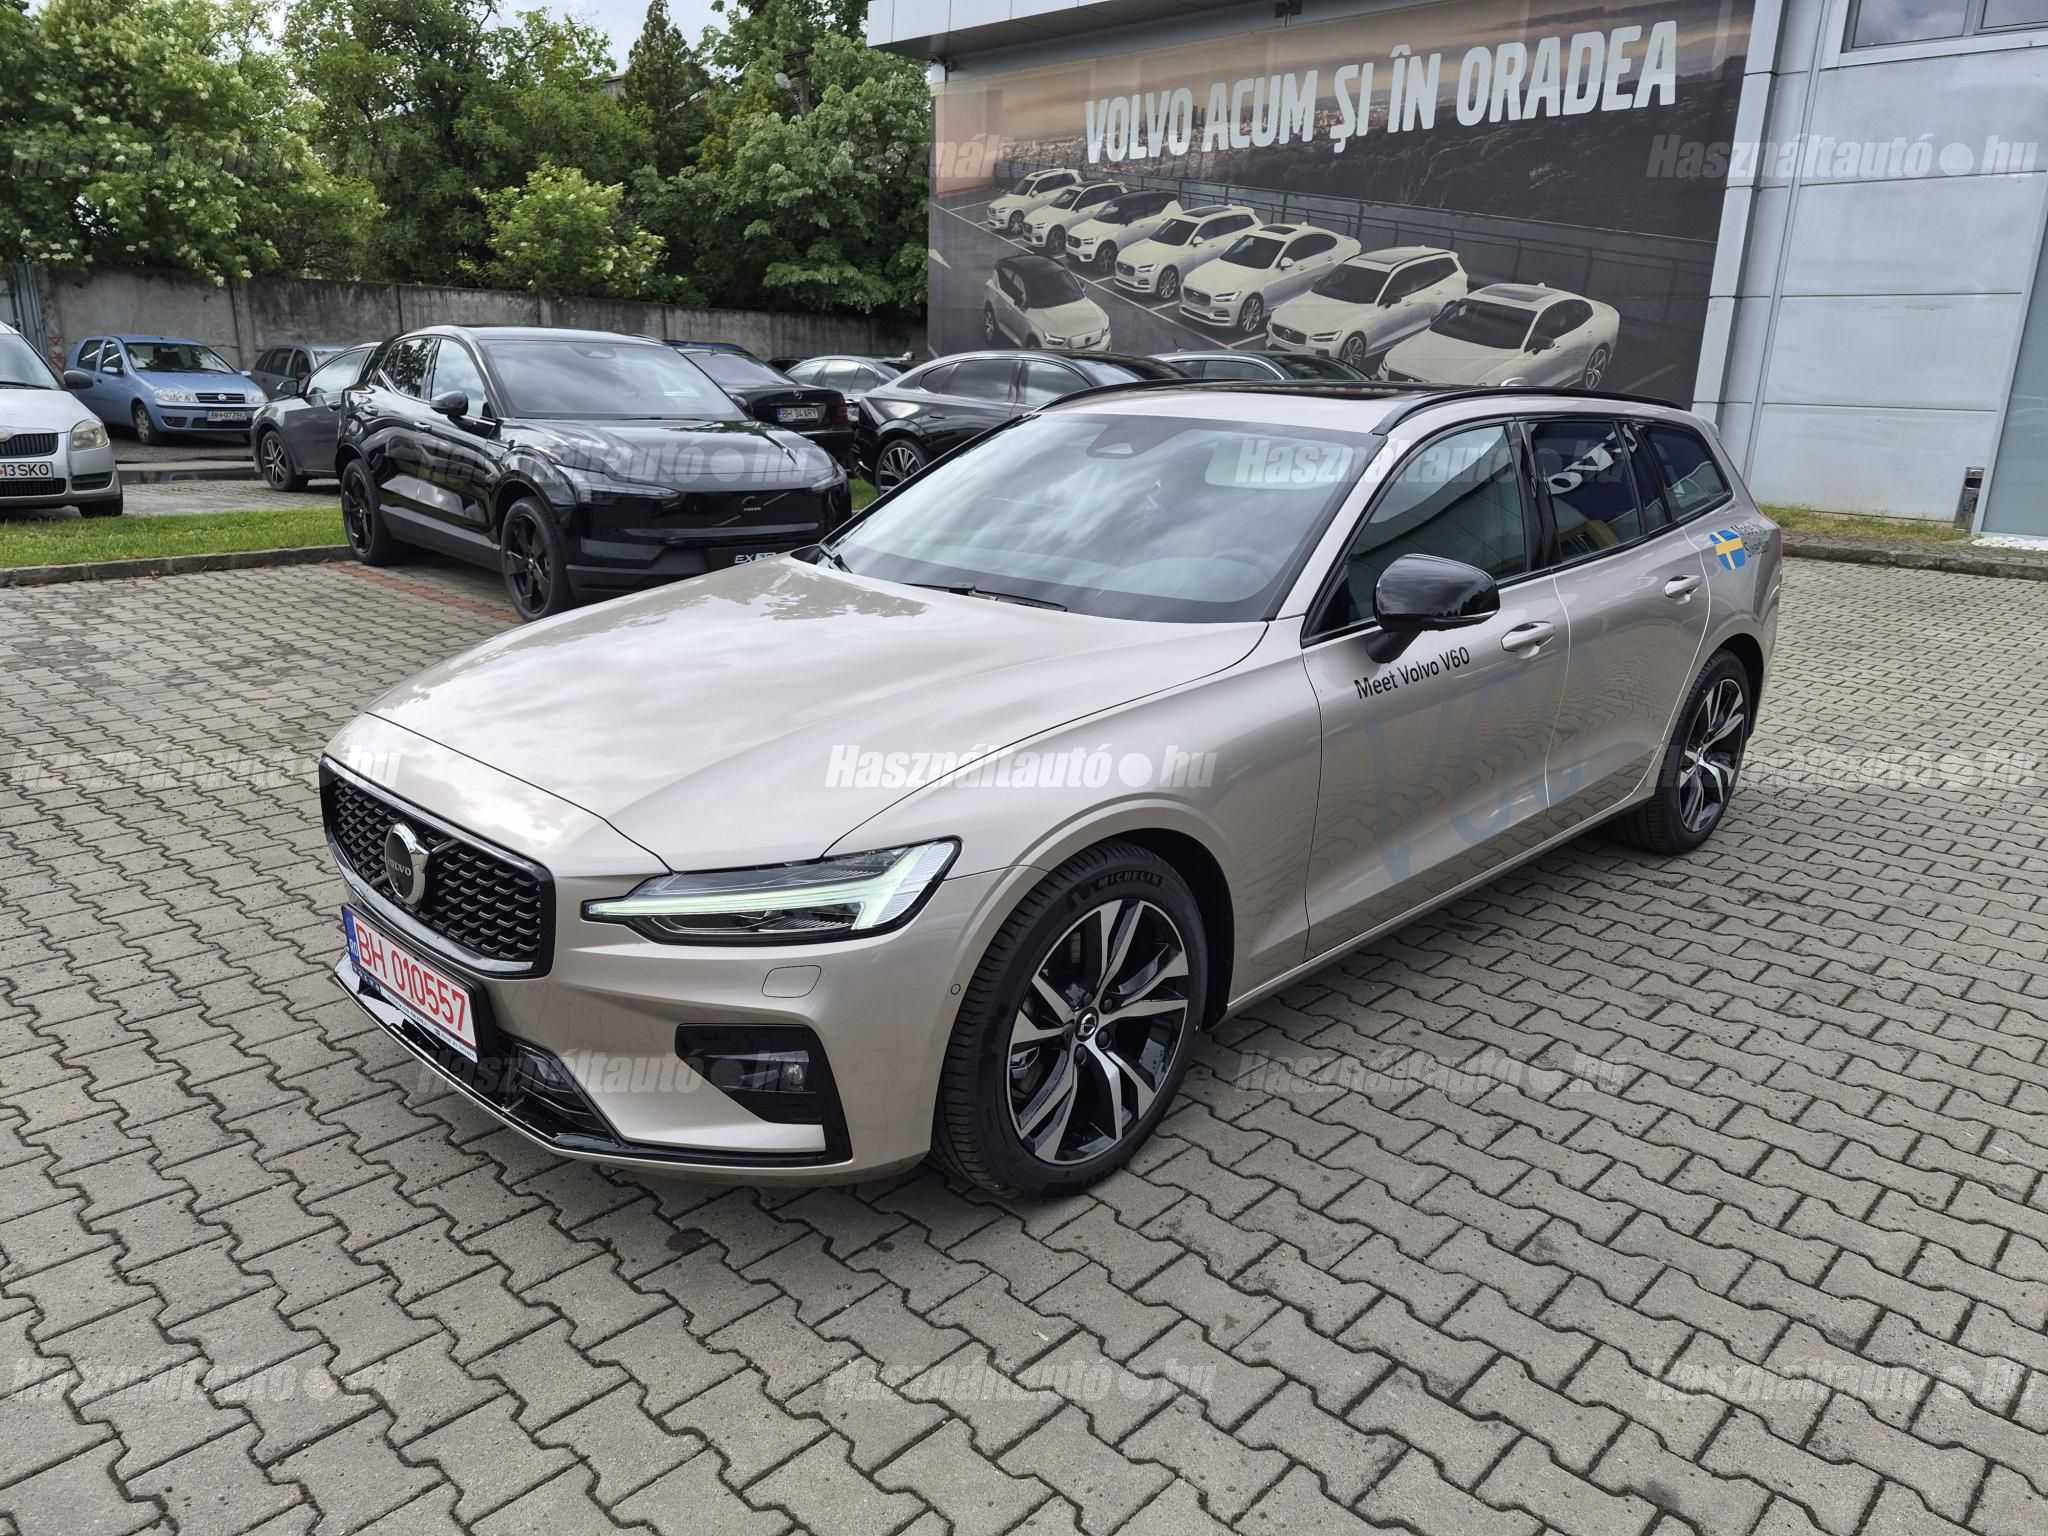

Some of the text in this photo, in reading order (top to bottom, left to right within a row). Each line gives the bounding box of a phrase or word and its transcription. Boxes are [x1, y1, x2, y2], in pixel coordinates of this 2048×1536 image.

[1085, 87, 1193, 164] VOLVO
[1201, 70, 1318, 153] ACUM
[1387, 43, 1441, 134] ÎN
[1456, 20, 1677, 127] ORADEA
[1353, 646, 1470, 699] Meet Volvo V60
[387, 858, 412, 876] VOLVO
[355, 923, 388, 979] BH
[391, 950, 466, 1032] 010557
